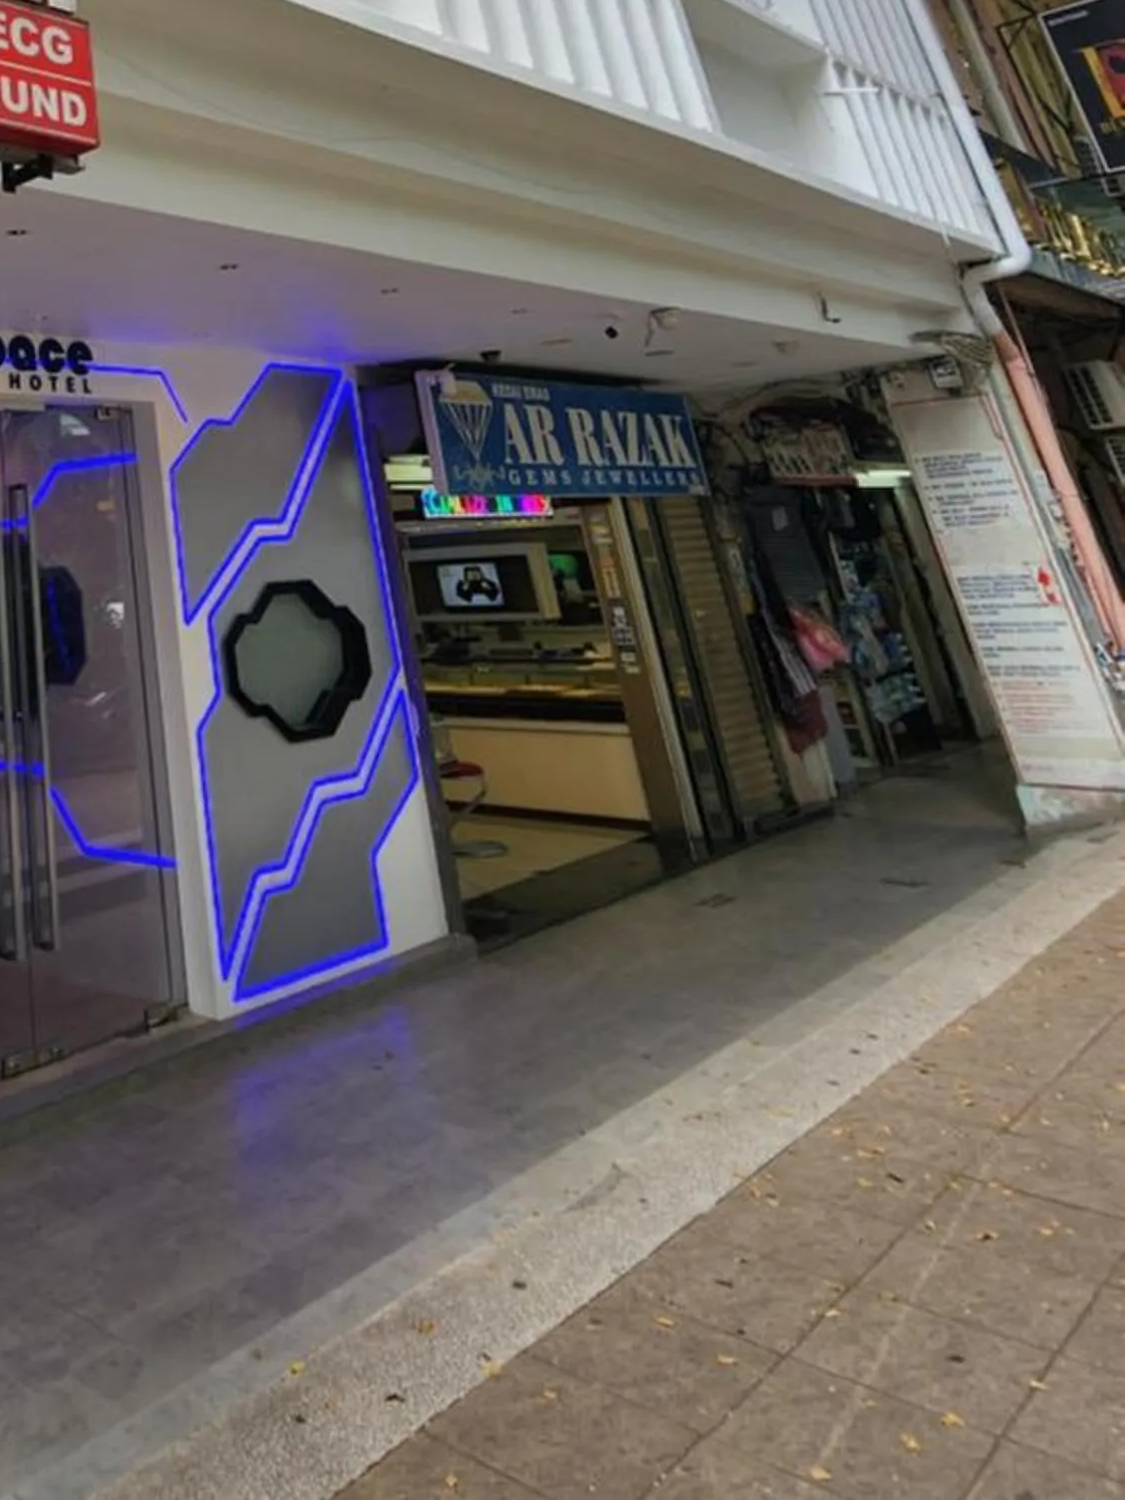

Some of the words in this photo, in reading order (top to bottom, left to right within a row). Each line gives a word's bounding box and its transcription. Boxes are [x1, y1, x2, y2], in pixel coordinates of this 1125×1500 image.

[8, 373, 93, 395] HOTEL
[503, 402, 565, 467] AR
[566, 406, 698, 469] RAZAK
[508, 467, 573, 487] GEMS
